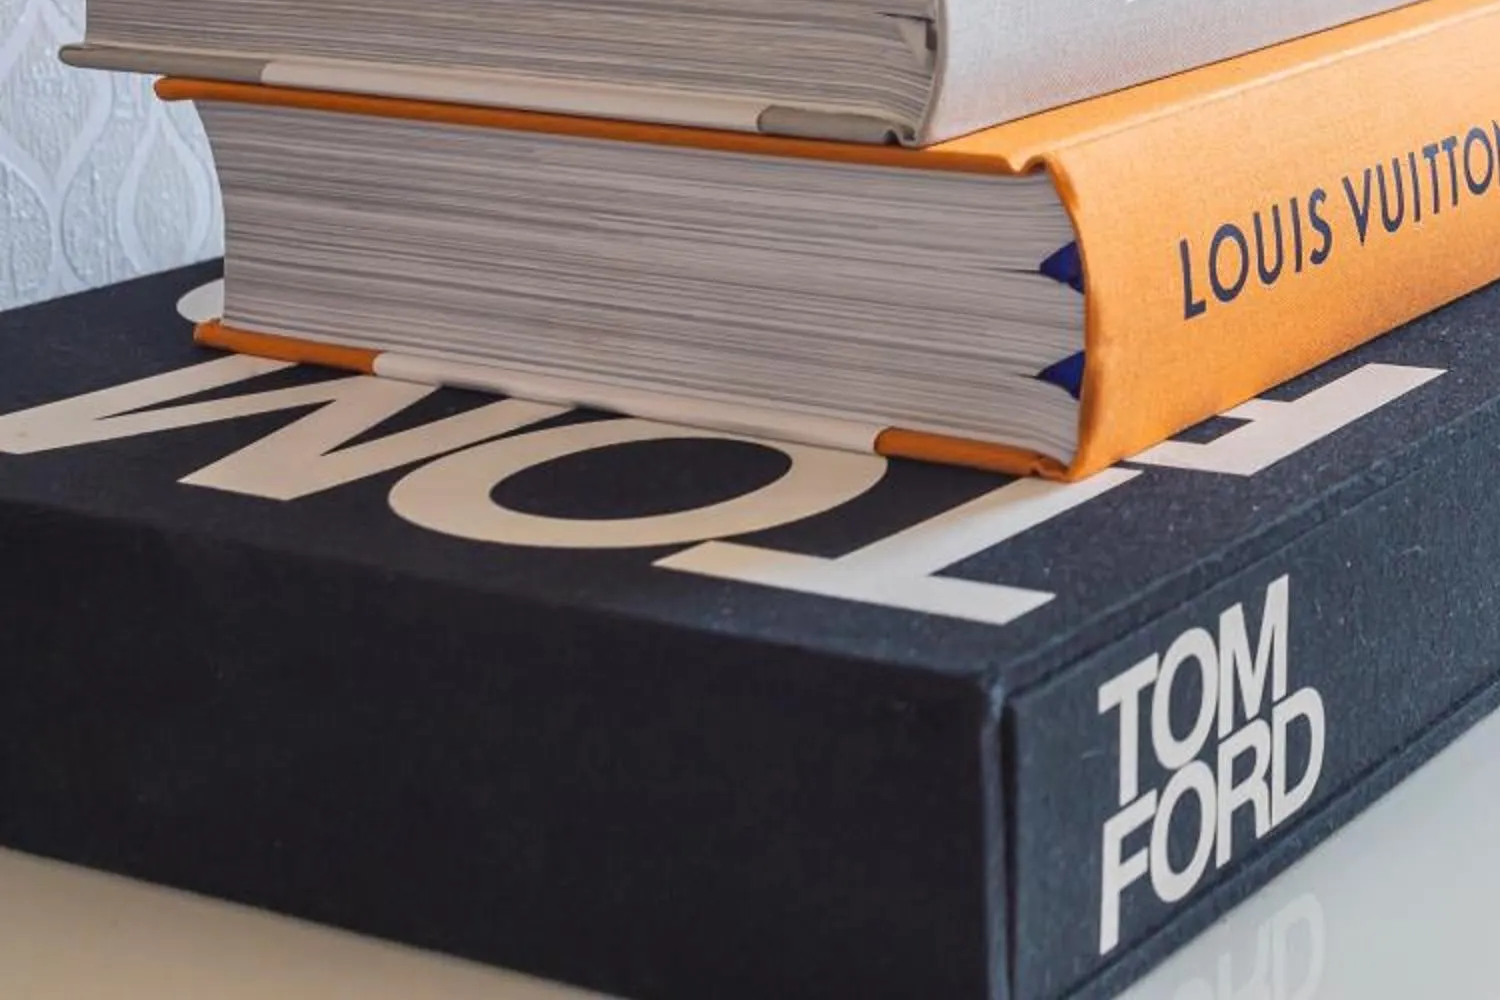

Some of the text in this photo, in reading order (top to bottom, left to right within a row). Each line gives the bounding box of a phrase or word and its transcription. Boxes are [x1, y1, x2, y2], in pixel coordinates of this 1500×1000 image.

[1180, 188, 1332, 320] LOUIS
[1098, 574, 1289, 806] TOM
[1100, 687, 1325, 955] FORD
